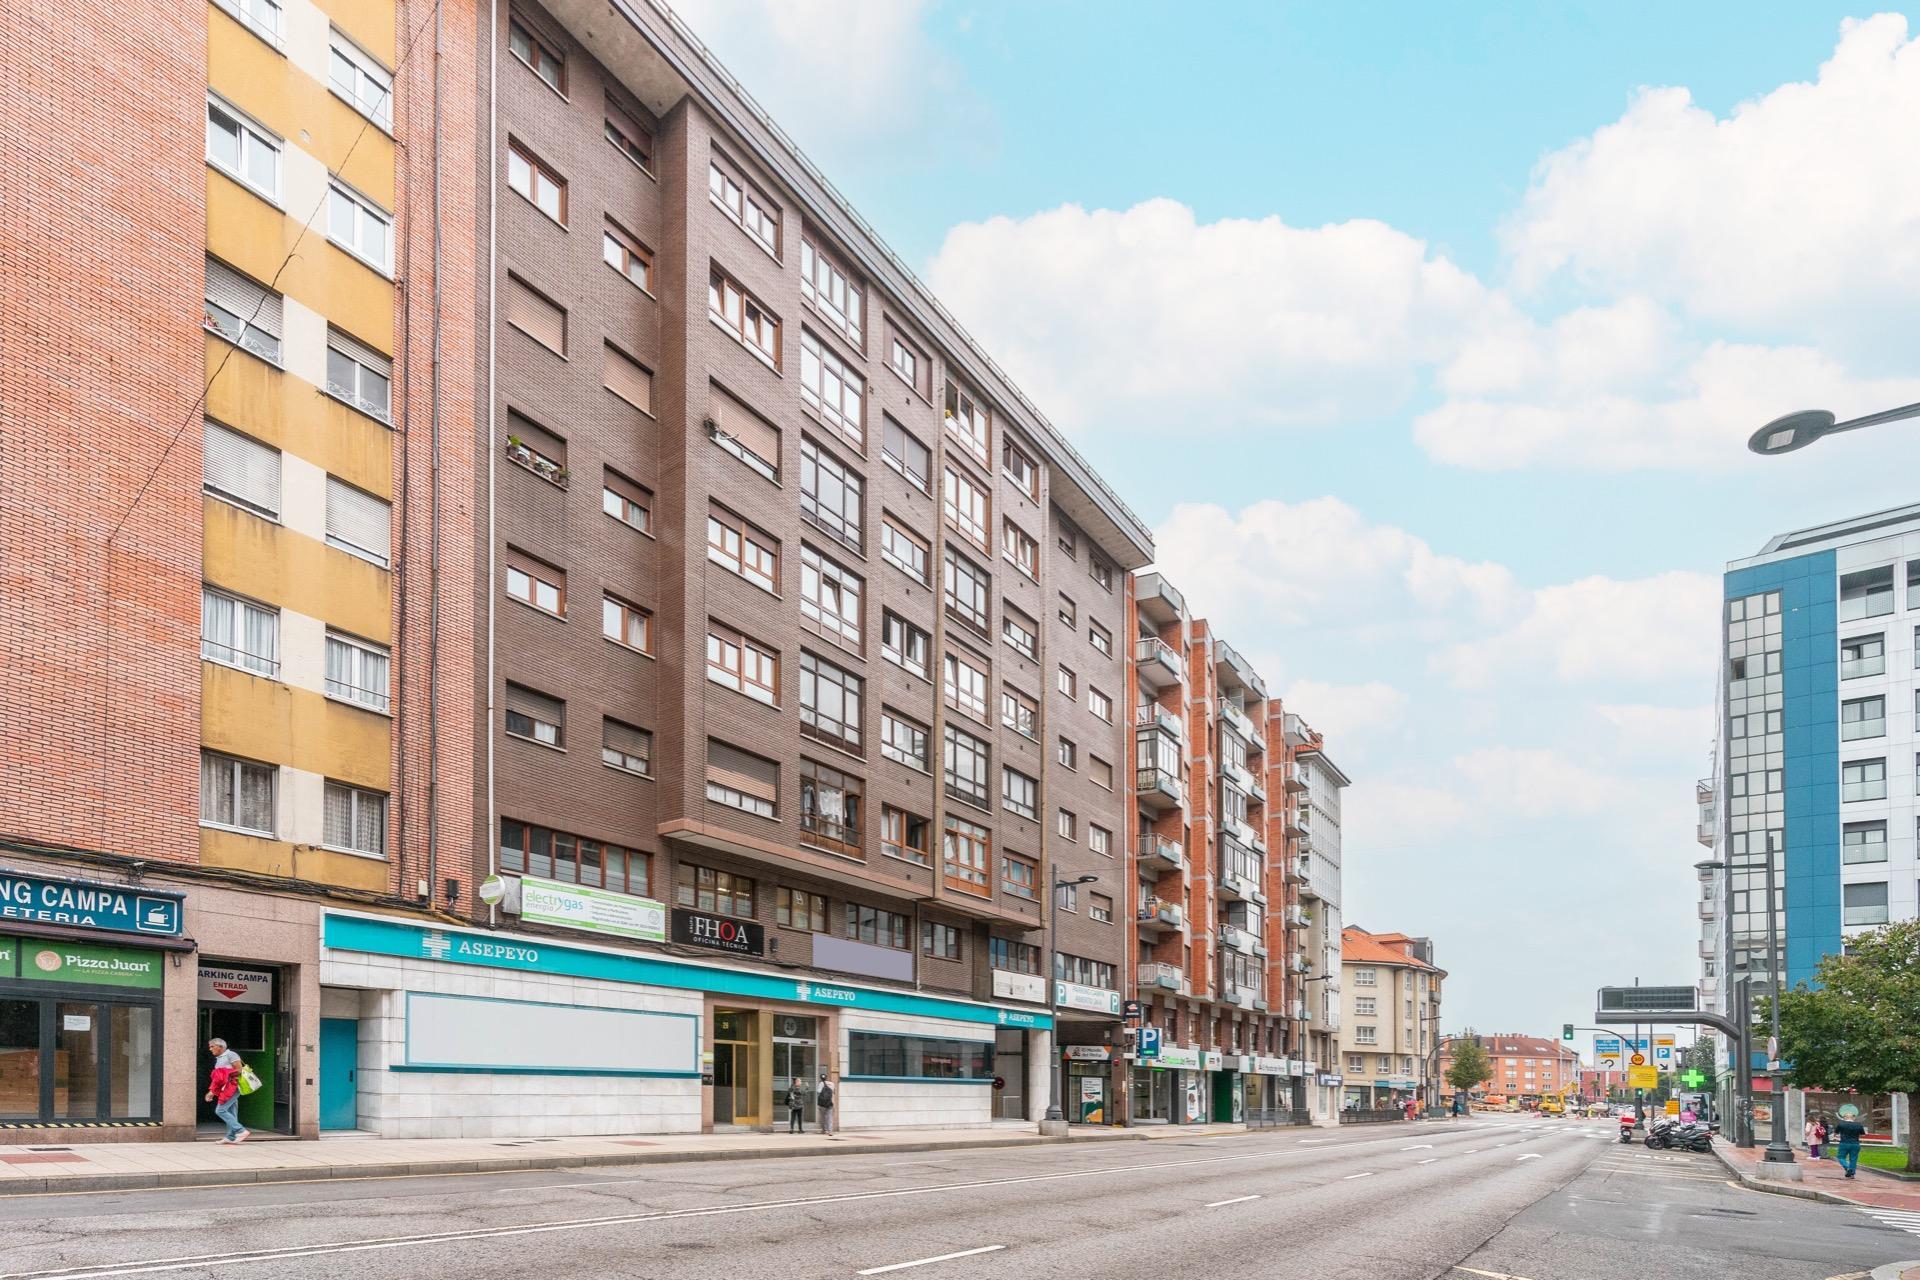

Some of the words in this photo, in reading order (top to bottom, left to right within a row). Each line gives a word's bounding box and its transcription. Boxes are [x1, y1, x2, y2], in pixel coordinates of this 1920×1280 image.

[41, 885, 128, 916] CAMPA
[3, 906, 96, 926] ETERIA
[694, 916, 749, 944] FHOA
[693, 936, 720, 945] OFICINA
[458, 941, 538, 962] ASEPEYO
[198, 970, 234, 980] ARKING
[237, 973, 269, 983] CAMPA
[213, 981, 248, 990] ENTRADA
[814, 987, 856, 1001] ASEPEYO
